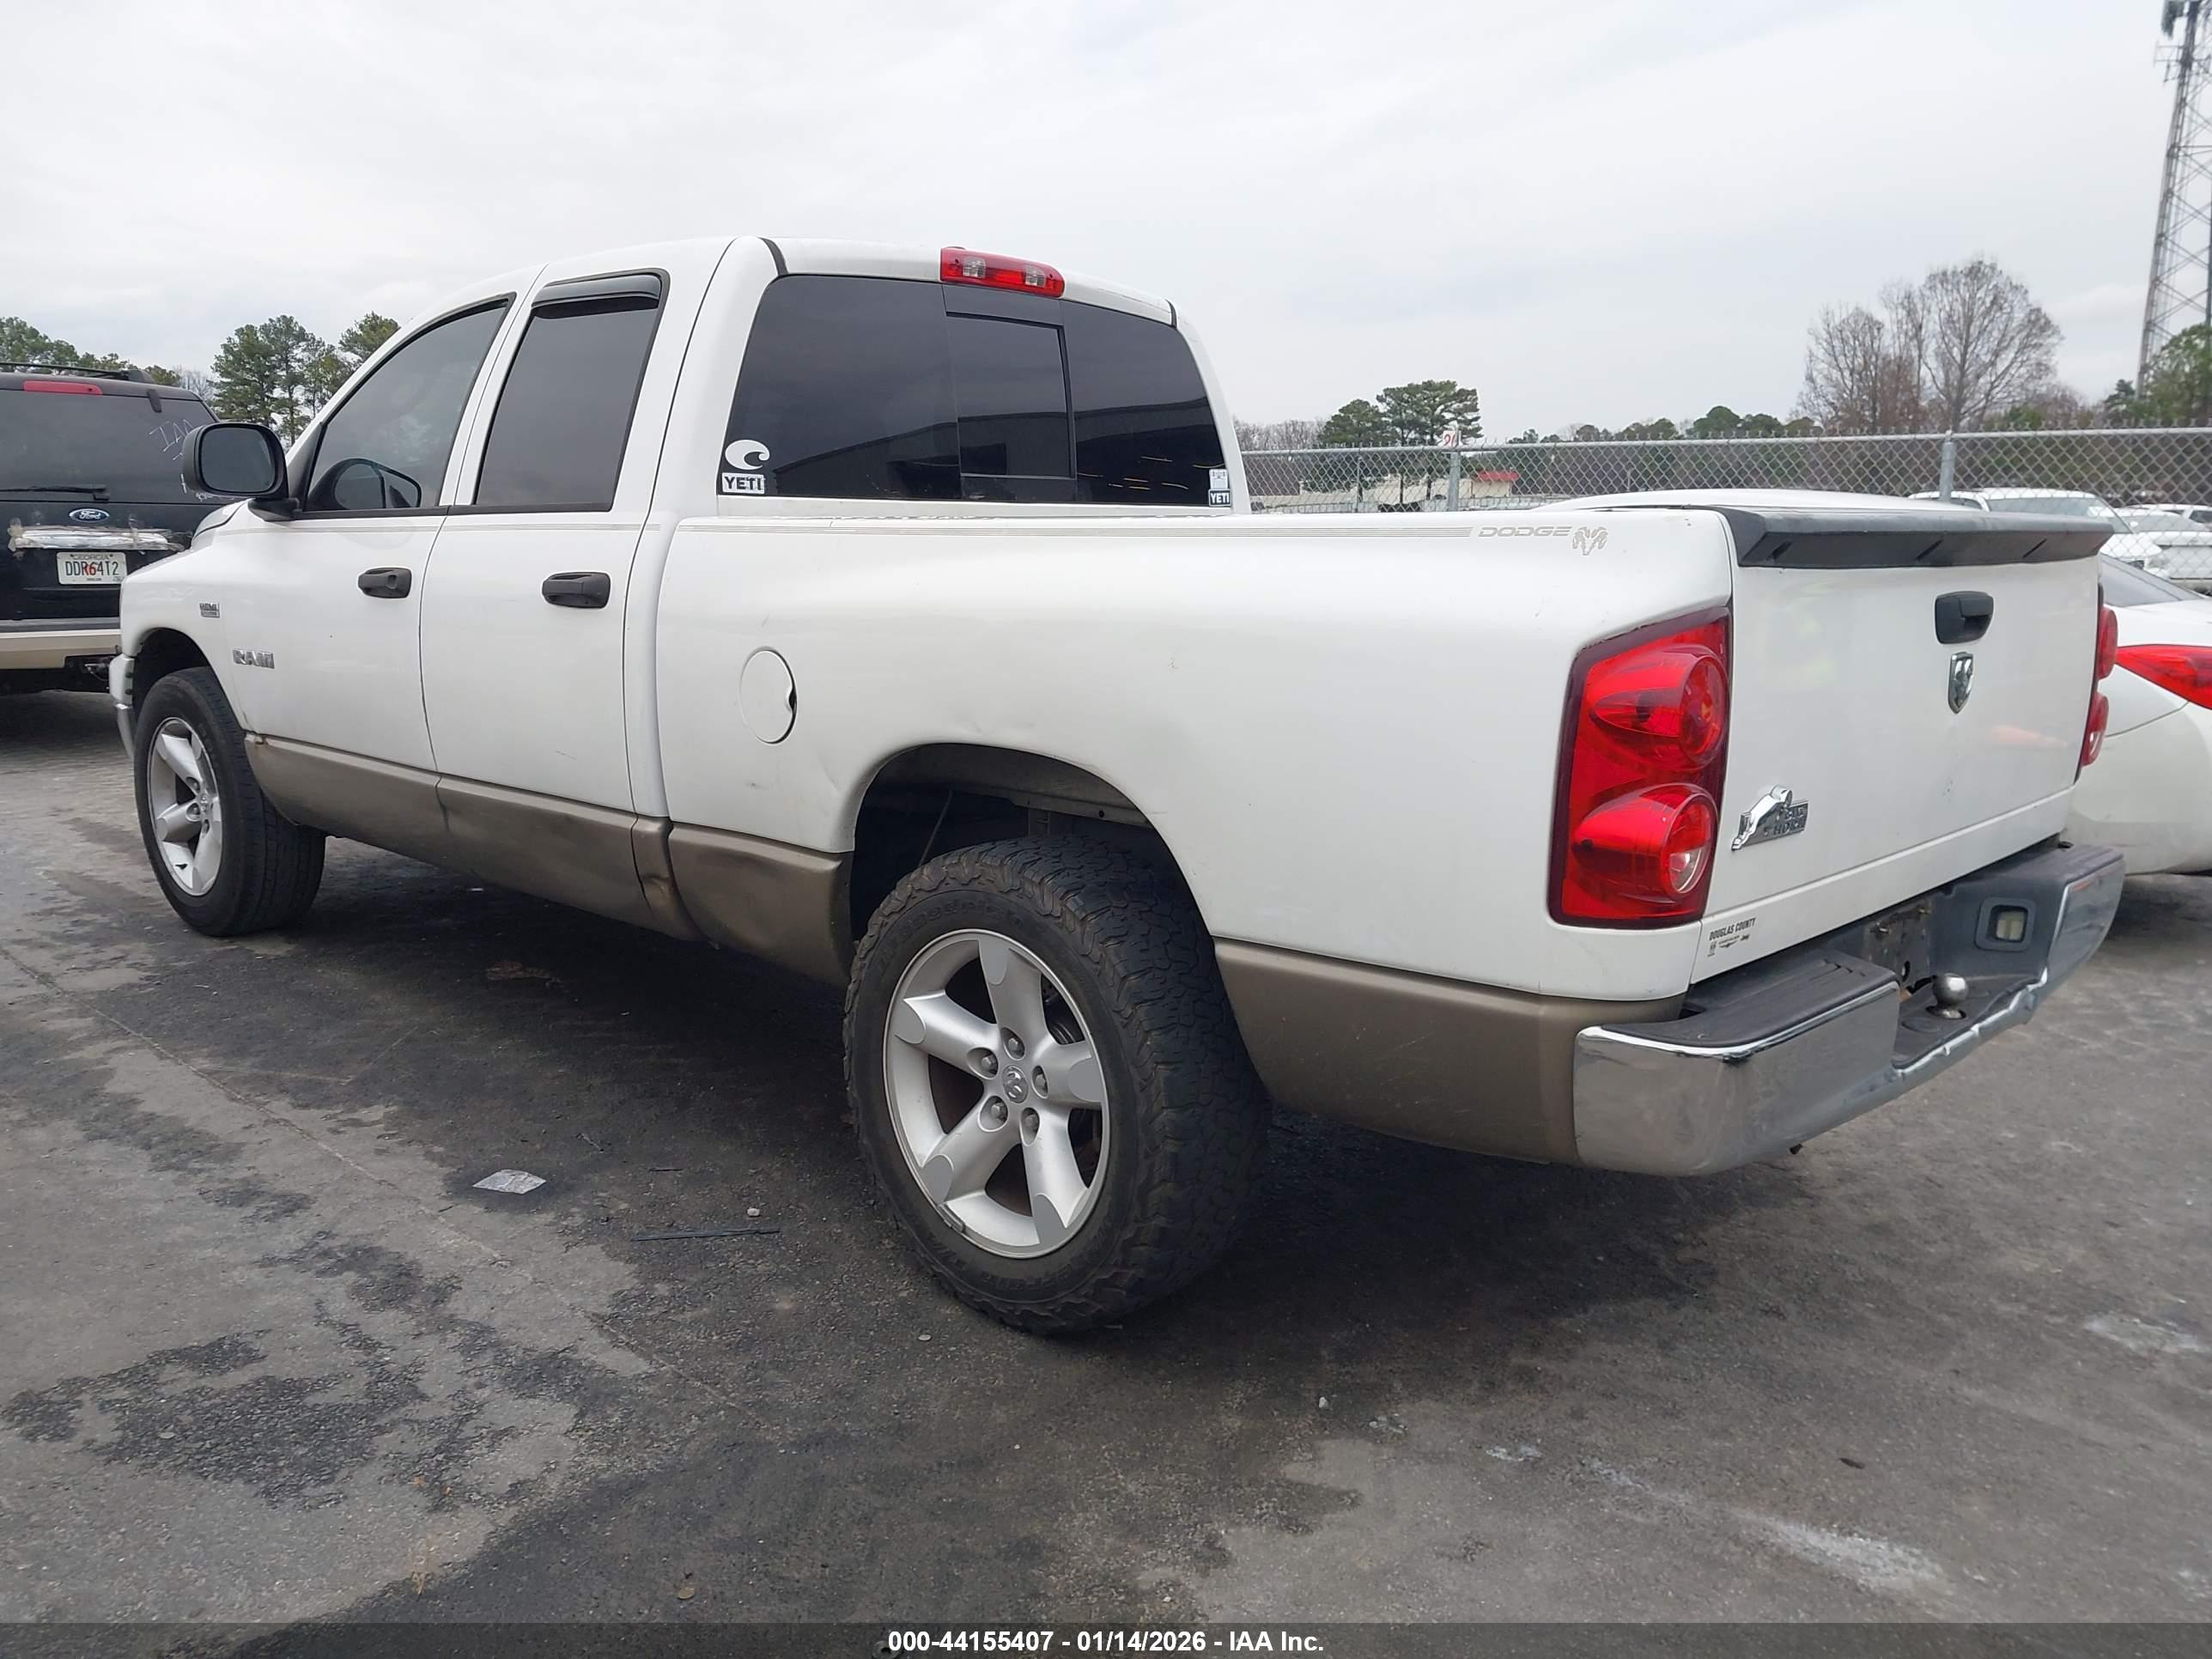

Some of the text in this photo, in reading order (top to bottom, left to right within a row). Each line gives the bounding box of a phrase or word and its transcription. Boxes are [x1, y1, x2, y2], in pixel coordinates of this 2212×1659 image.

[724, 476, 763, 490] YETI
[1210, 492, 1230, 504] YETI
[1478, 526, 1573, 538] DODGE
[233, 649, 275, 668] RAM
[1709, 924, 1735, 941] DOUGLAS
[1735, 916, 1756, 933] COUNTY
